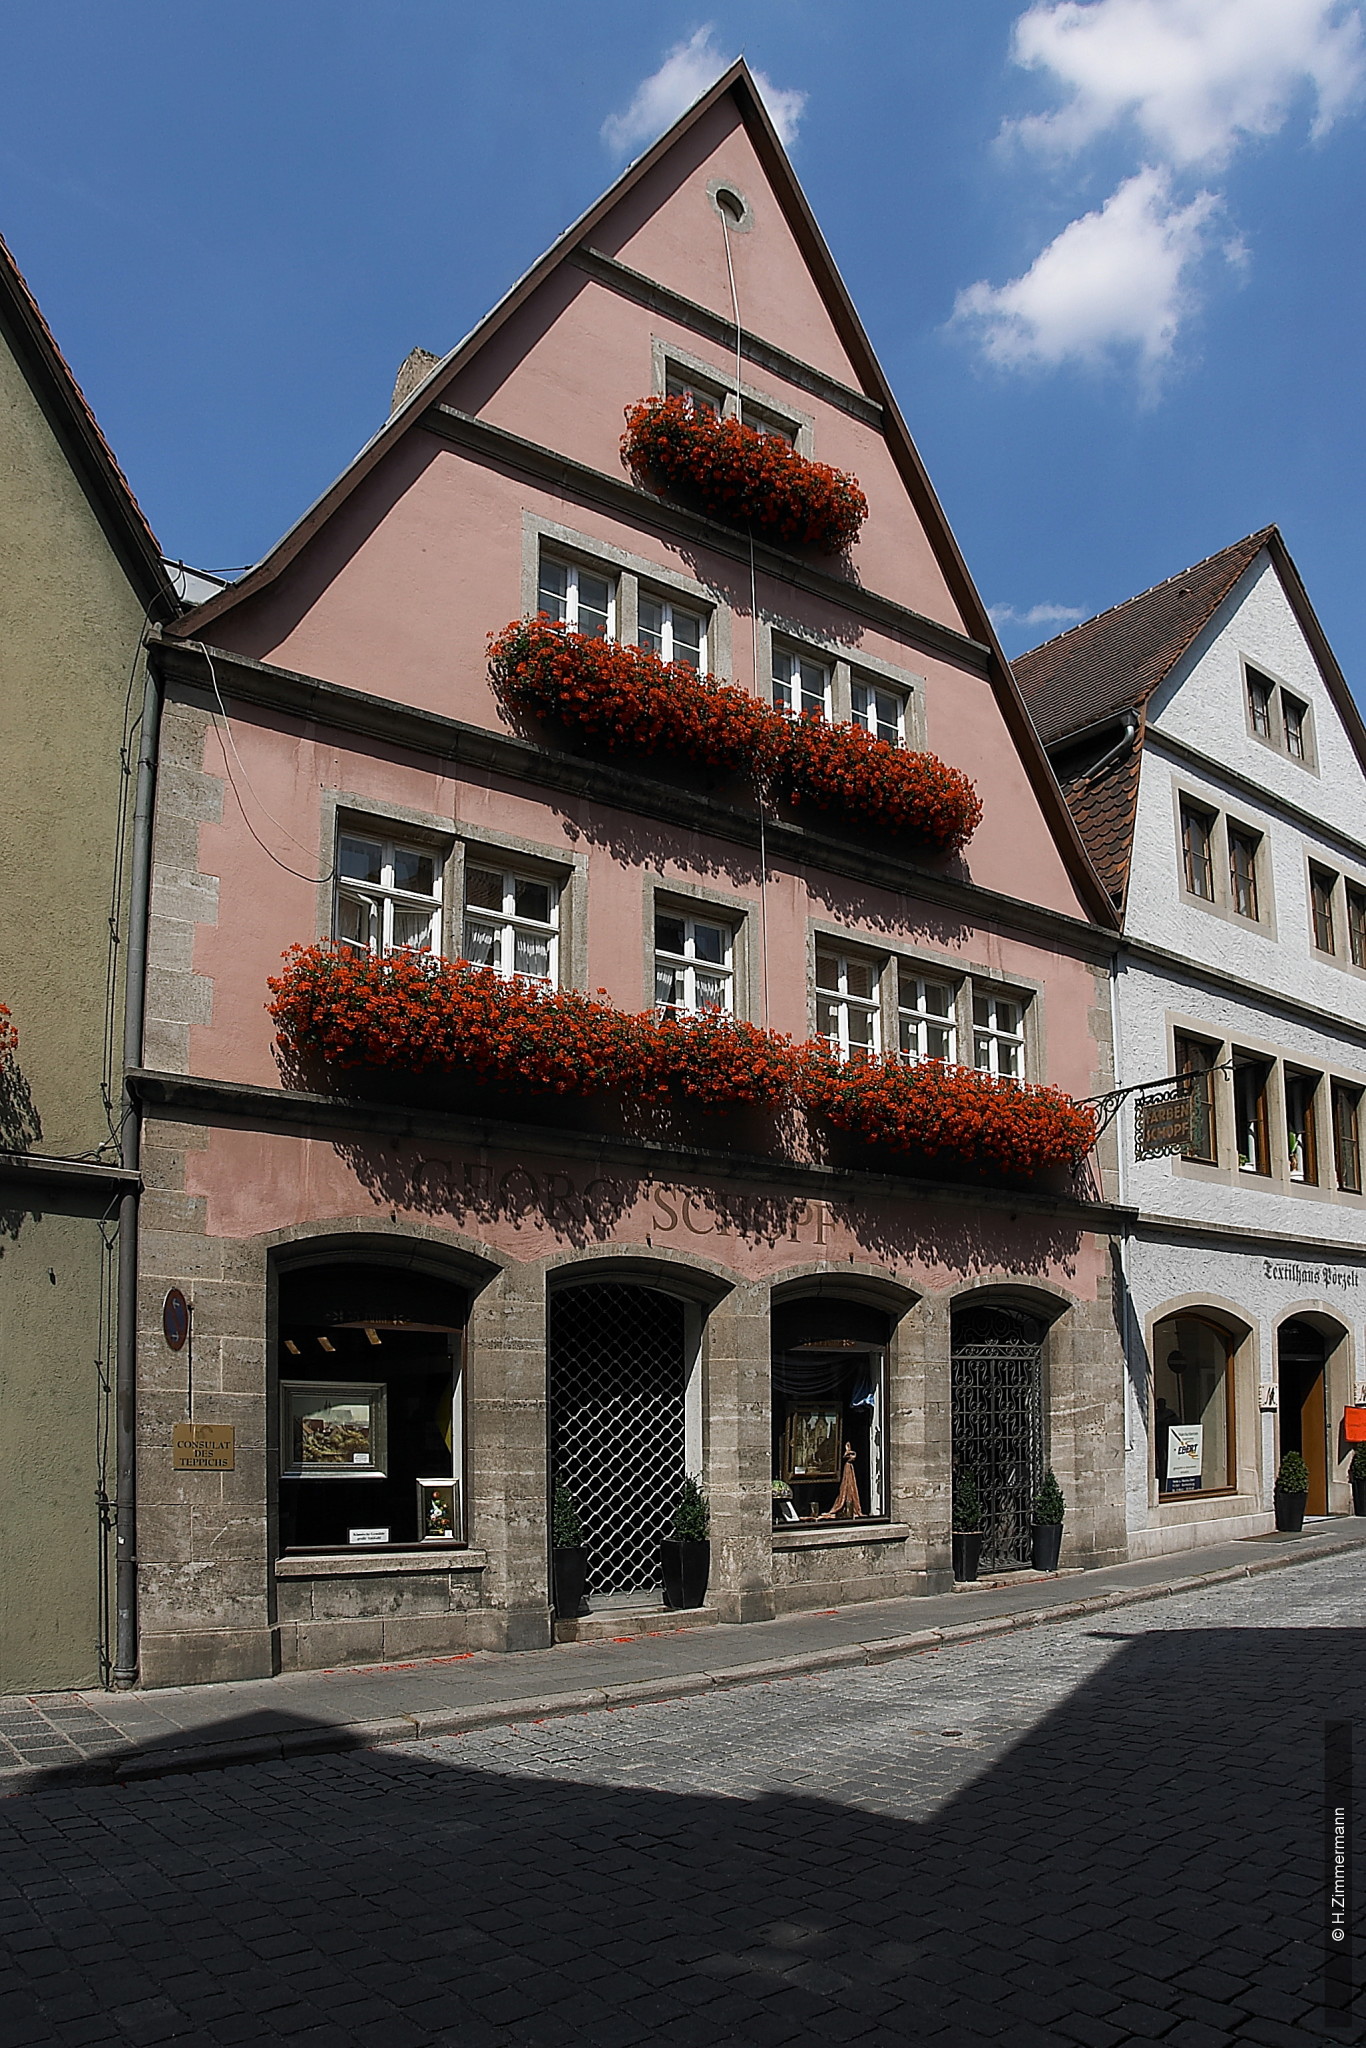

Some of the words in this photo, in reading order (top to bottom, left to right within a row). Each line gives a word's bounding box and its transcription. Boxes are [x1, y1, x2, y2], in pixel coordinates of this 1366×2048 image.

[1146, 1103, 1190, 1124] FARBEN
[412, 1158, 620, 1224] GEORG
[1263, 1259, 1321, 1287] Textilhaus
[177, 1440, 231, 1450] CONSULAT
[194, 1449, 214, 1458] DES
[179, 1457, 228, 1467] TEPPICHS
